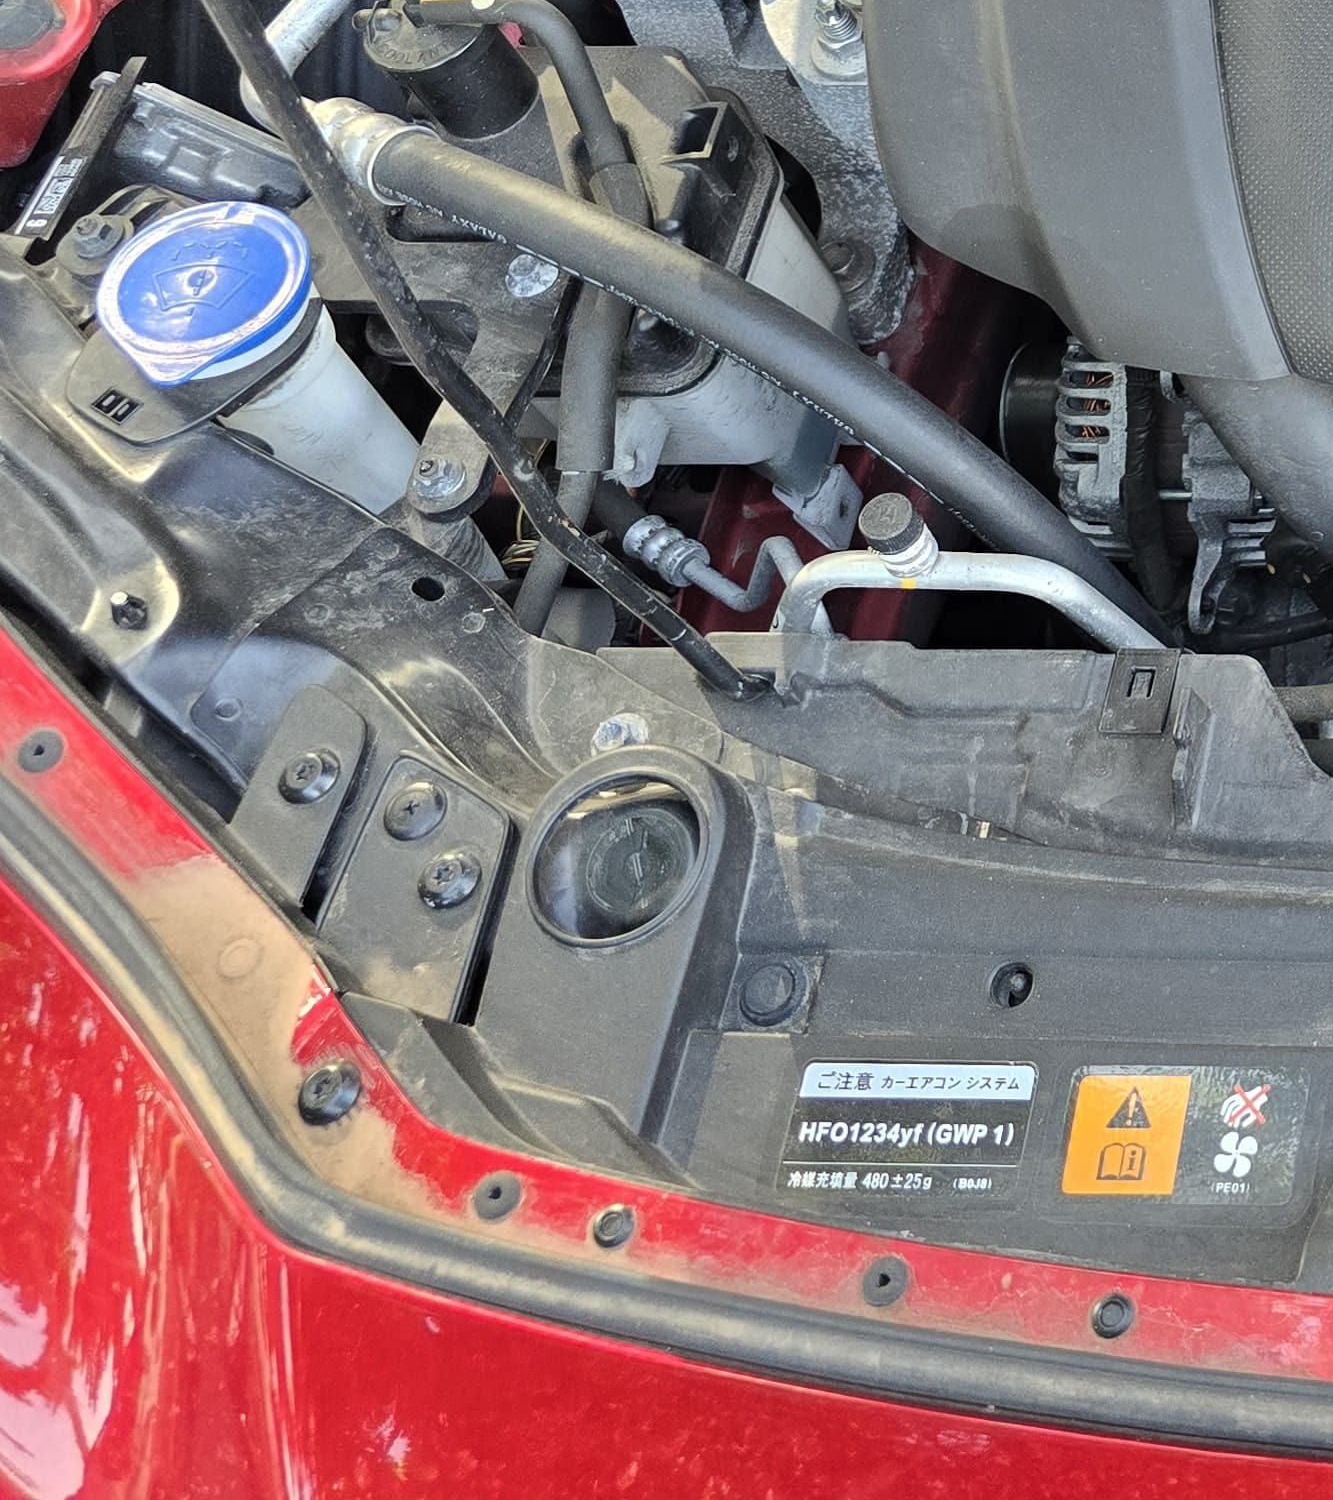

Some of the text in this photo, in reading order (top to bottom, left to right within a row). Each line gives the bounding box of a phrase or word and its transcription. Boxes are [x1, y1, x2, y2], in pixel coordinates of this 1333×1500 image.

[818, 1072, 1020, 1091] ご注意 カーエアコン システム
[798, 1121, 1015, 1148] HFO1234yf (GWP 1)
[1211, 1180, 1250, 1194] (PE01)
